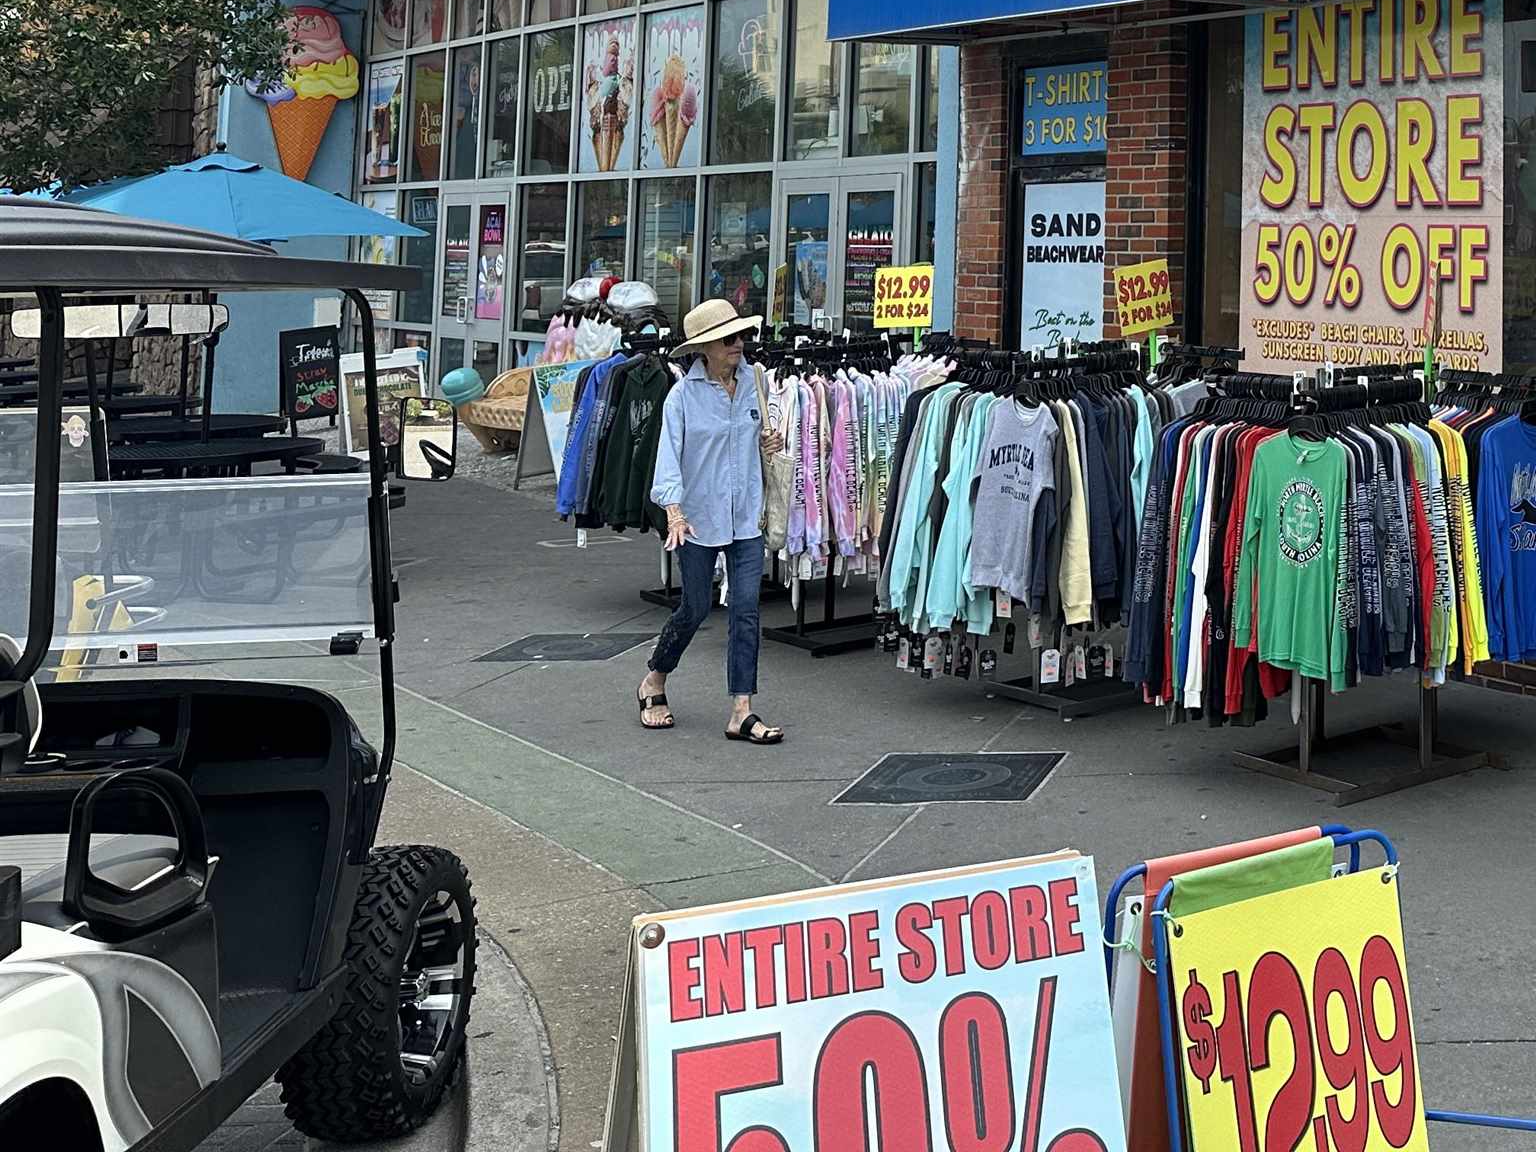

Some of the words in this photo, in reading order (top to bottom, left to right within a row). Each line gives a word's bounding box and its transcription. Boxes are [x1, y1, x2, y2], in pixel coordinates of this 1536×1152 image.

[534, 64, 572, 113] OPE
[1025, 120, 1035, 145] 3
[1041, 117, 1077, 144] FOR
[1259, 95, 1486, 211] STORE
[1031, 213, 1101, 238] SAND
[1027, 245, 1104, 264] BEACHWEAR
[1253, 223, 1362, 310] 50%
[1381, 222, 1490, 313] OFF
[877, 274, 931, 303] $12.99
[1118, 270, 1169, 307] $12.99
[876, 306, 883, 319] 2
[885, 305, 904, 318] FOR
[907, 301, 929, 320] $24
[1121, 311, 1130, 328] 2
[1132, 306, 1154, 325] FOR
[1321, 322, 1357, 342] BEACH
[1360, 325, 1408, 347] CHAIRS,
[1412, 329, 1489, 355] UMRELLAS,
[1332, 348, 1363, 365] BODY
[1364, 349, 1391, 365] AND
[668, 910, 884, 1024] ENTIRE
[895, 878, 1086, 984] STORE
